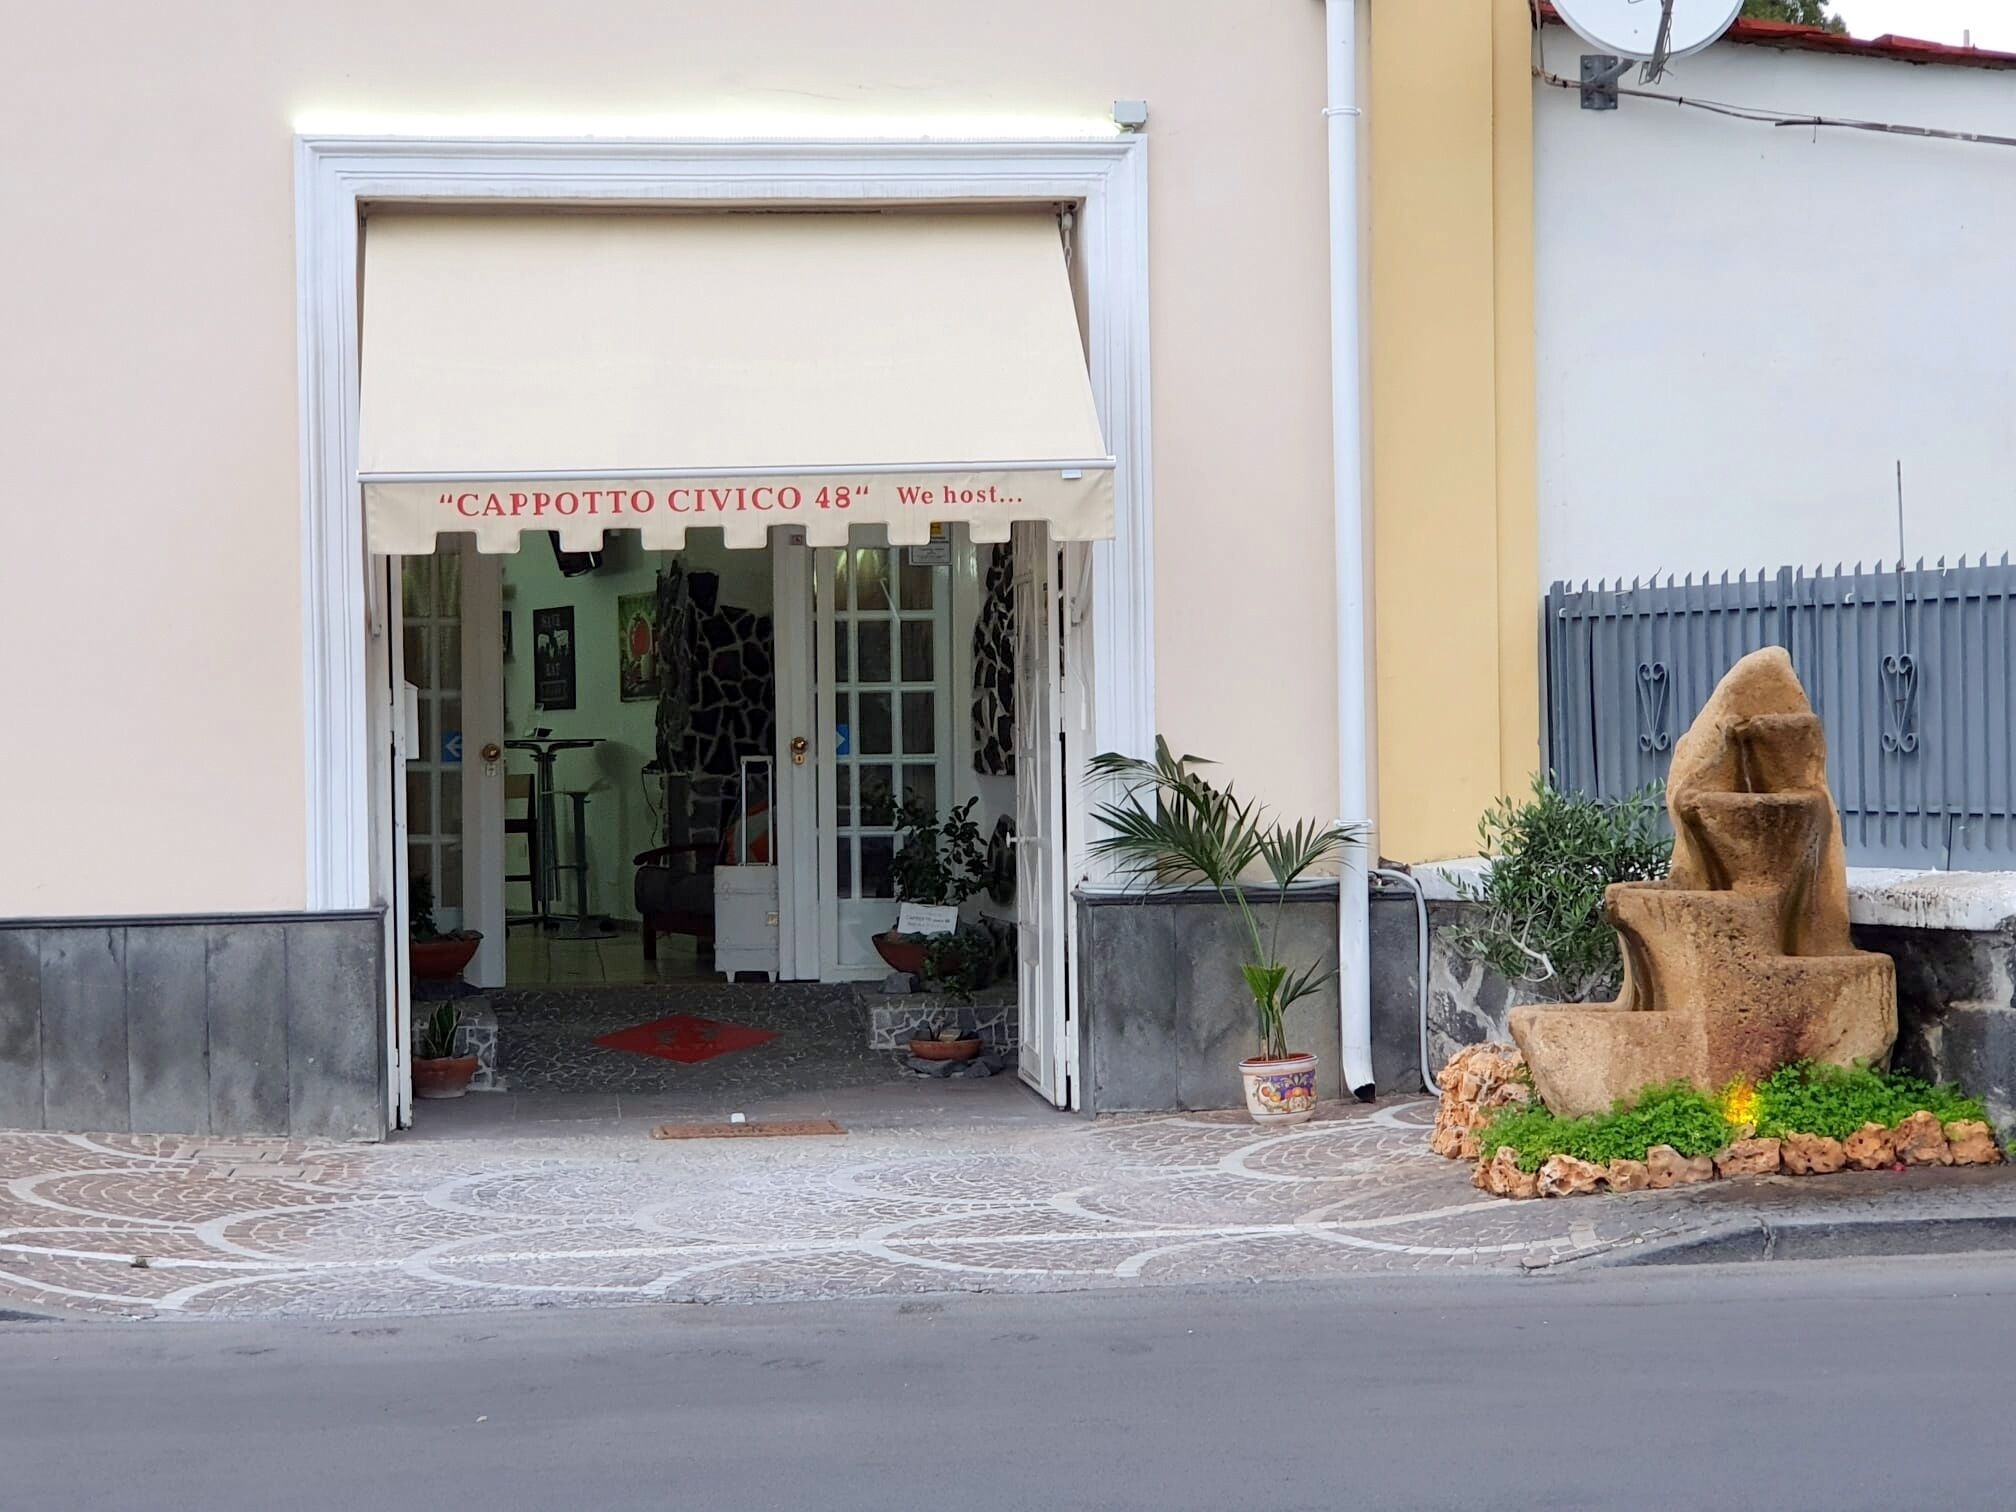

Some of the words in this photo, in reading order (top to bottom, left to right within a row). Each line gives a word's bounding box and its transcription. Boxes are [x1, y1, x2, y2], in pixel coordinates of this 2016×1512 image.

[667, 486, 802, 512] CIVICO
[897, 486, 934, 505] We
[943, 485, 1023, 503] host...
